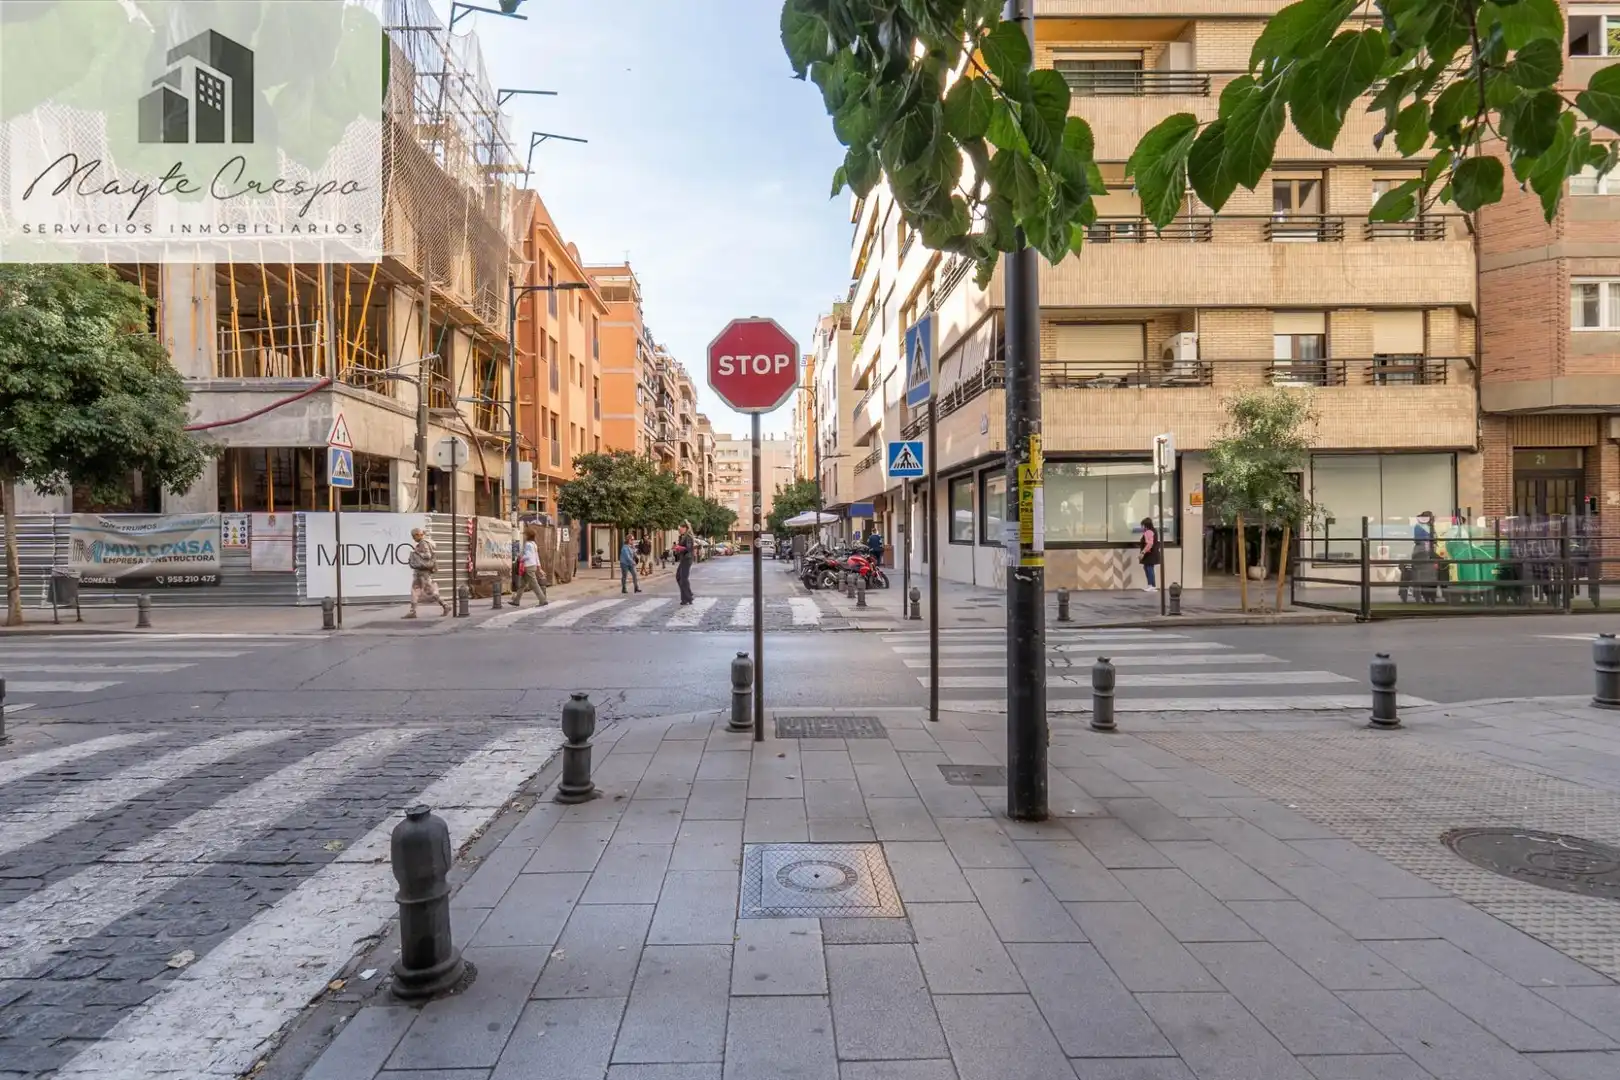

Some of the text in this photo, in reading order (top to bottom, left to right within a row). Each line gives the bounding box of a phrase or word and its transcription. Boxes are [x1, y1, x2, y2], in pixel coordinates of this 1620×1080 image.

[718, 354, 790, 376] STOP
[104, 540, 216, 557] MULCONSA
[103, 556, 144, 564] EMPRESA
[167, 575, 184, 583] 958
[184, 575, 199, 583] 210
[201, 574, 216, 583] 475
